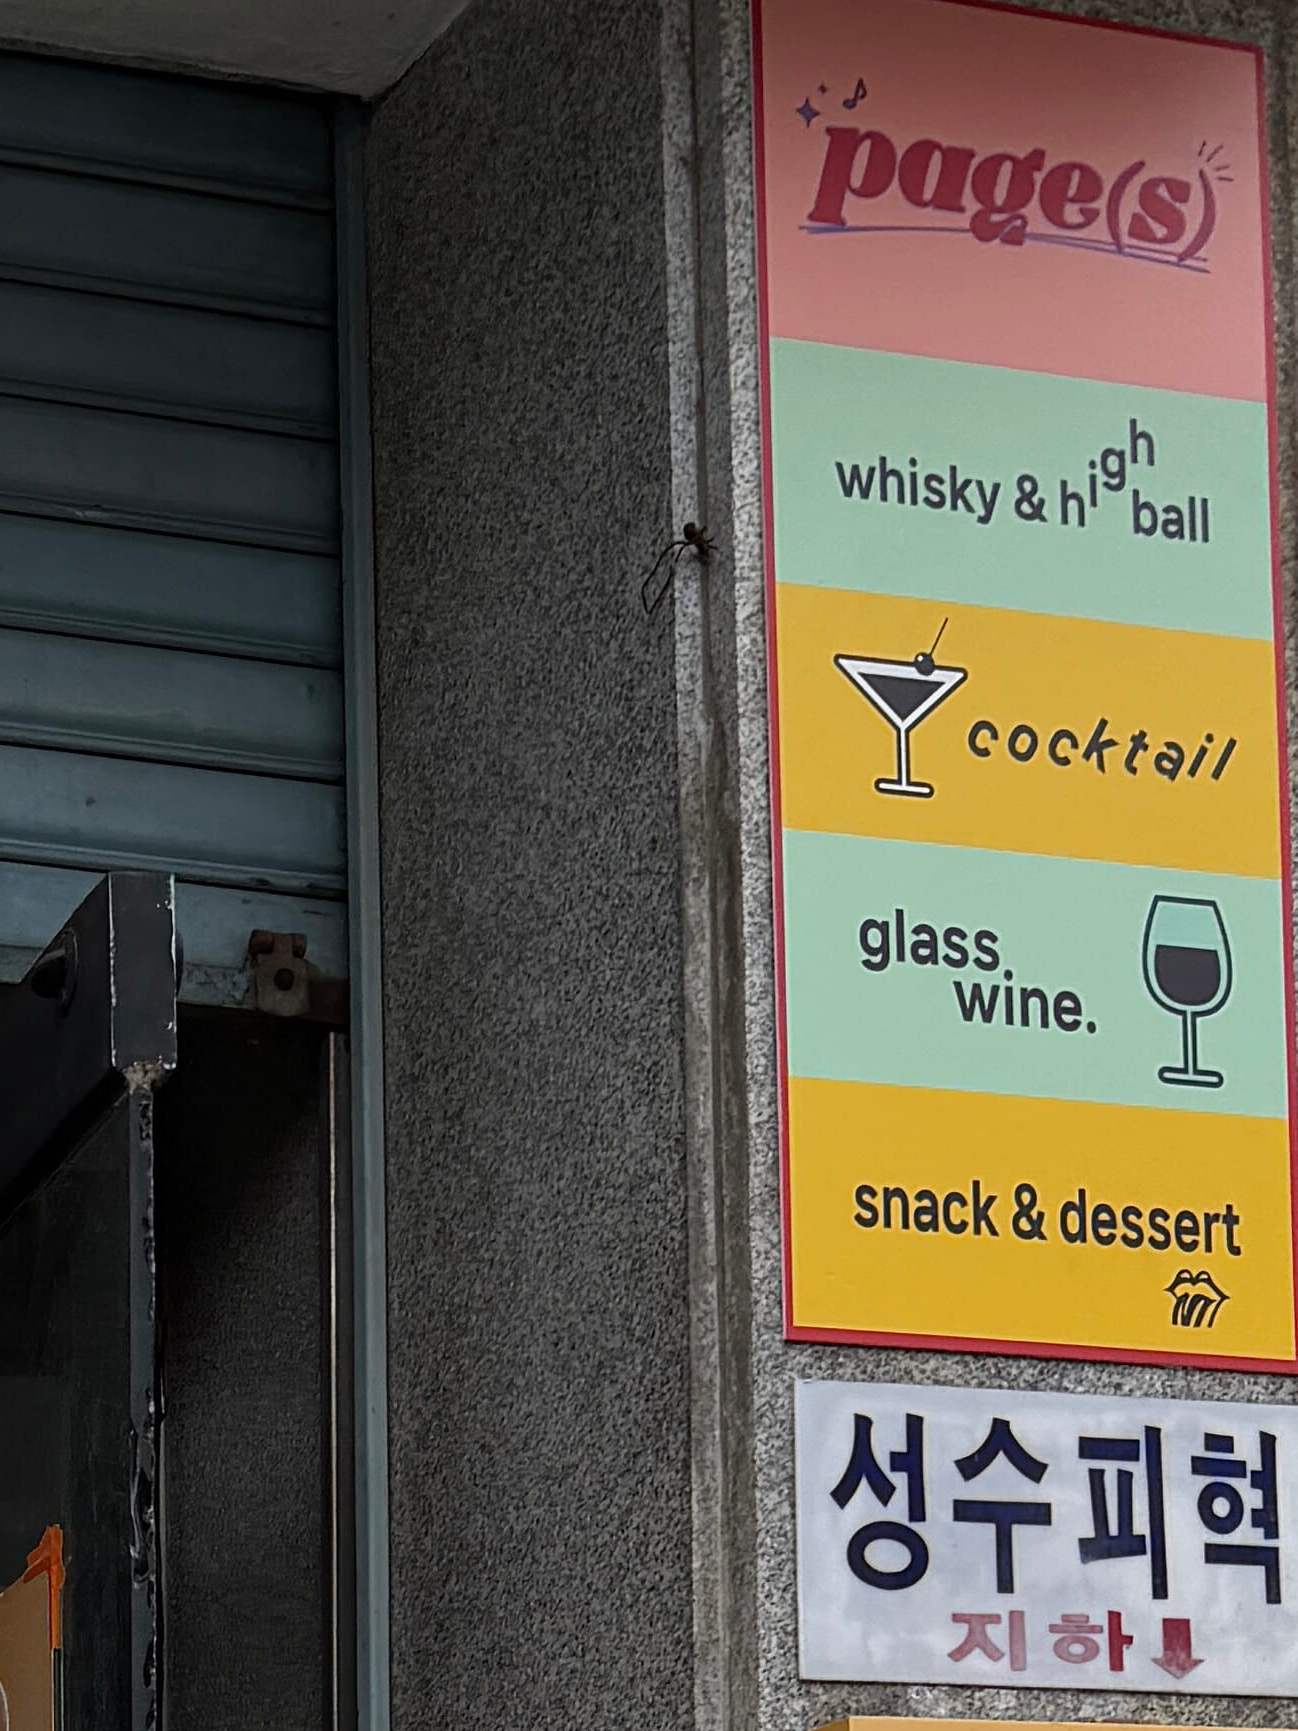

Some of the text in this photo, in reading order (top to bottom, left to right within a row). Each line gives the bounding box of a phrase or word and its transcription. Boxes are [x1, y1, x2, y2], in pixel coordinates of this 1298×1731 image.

[807, 125, 1217, 262] page(s)
[835, 455, 1001, 524] whisky
[1014, 474, 1048, 522] &
[967, 718, 1238, 782] cocktail
[952, 970, 1098, 1034] wine.
[853, 1179, 1242, 1257] snack & dessert
[829, 1412, 1282, 1605] 성수피혁
[947, 1610, 1134, 1672] 지하
